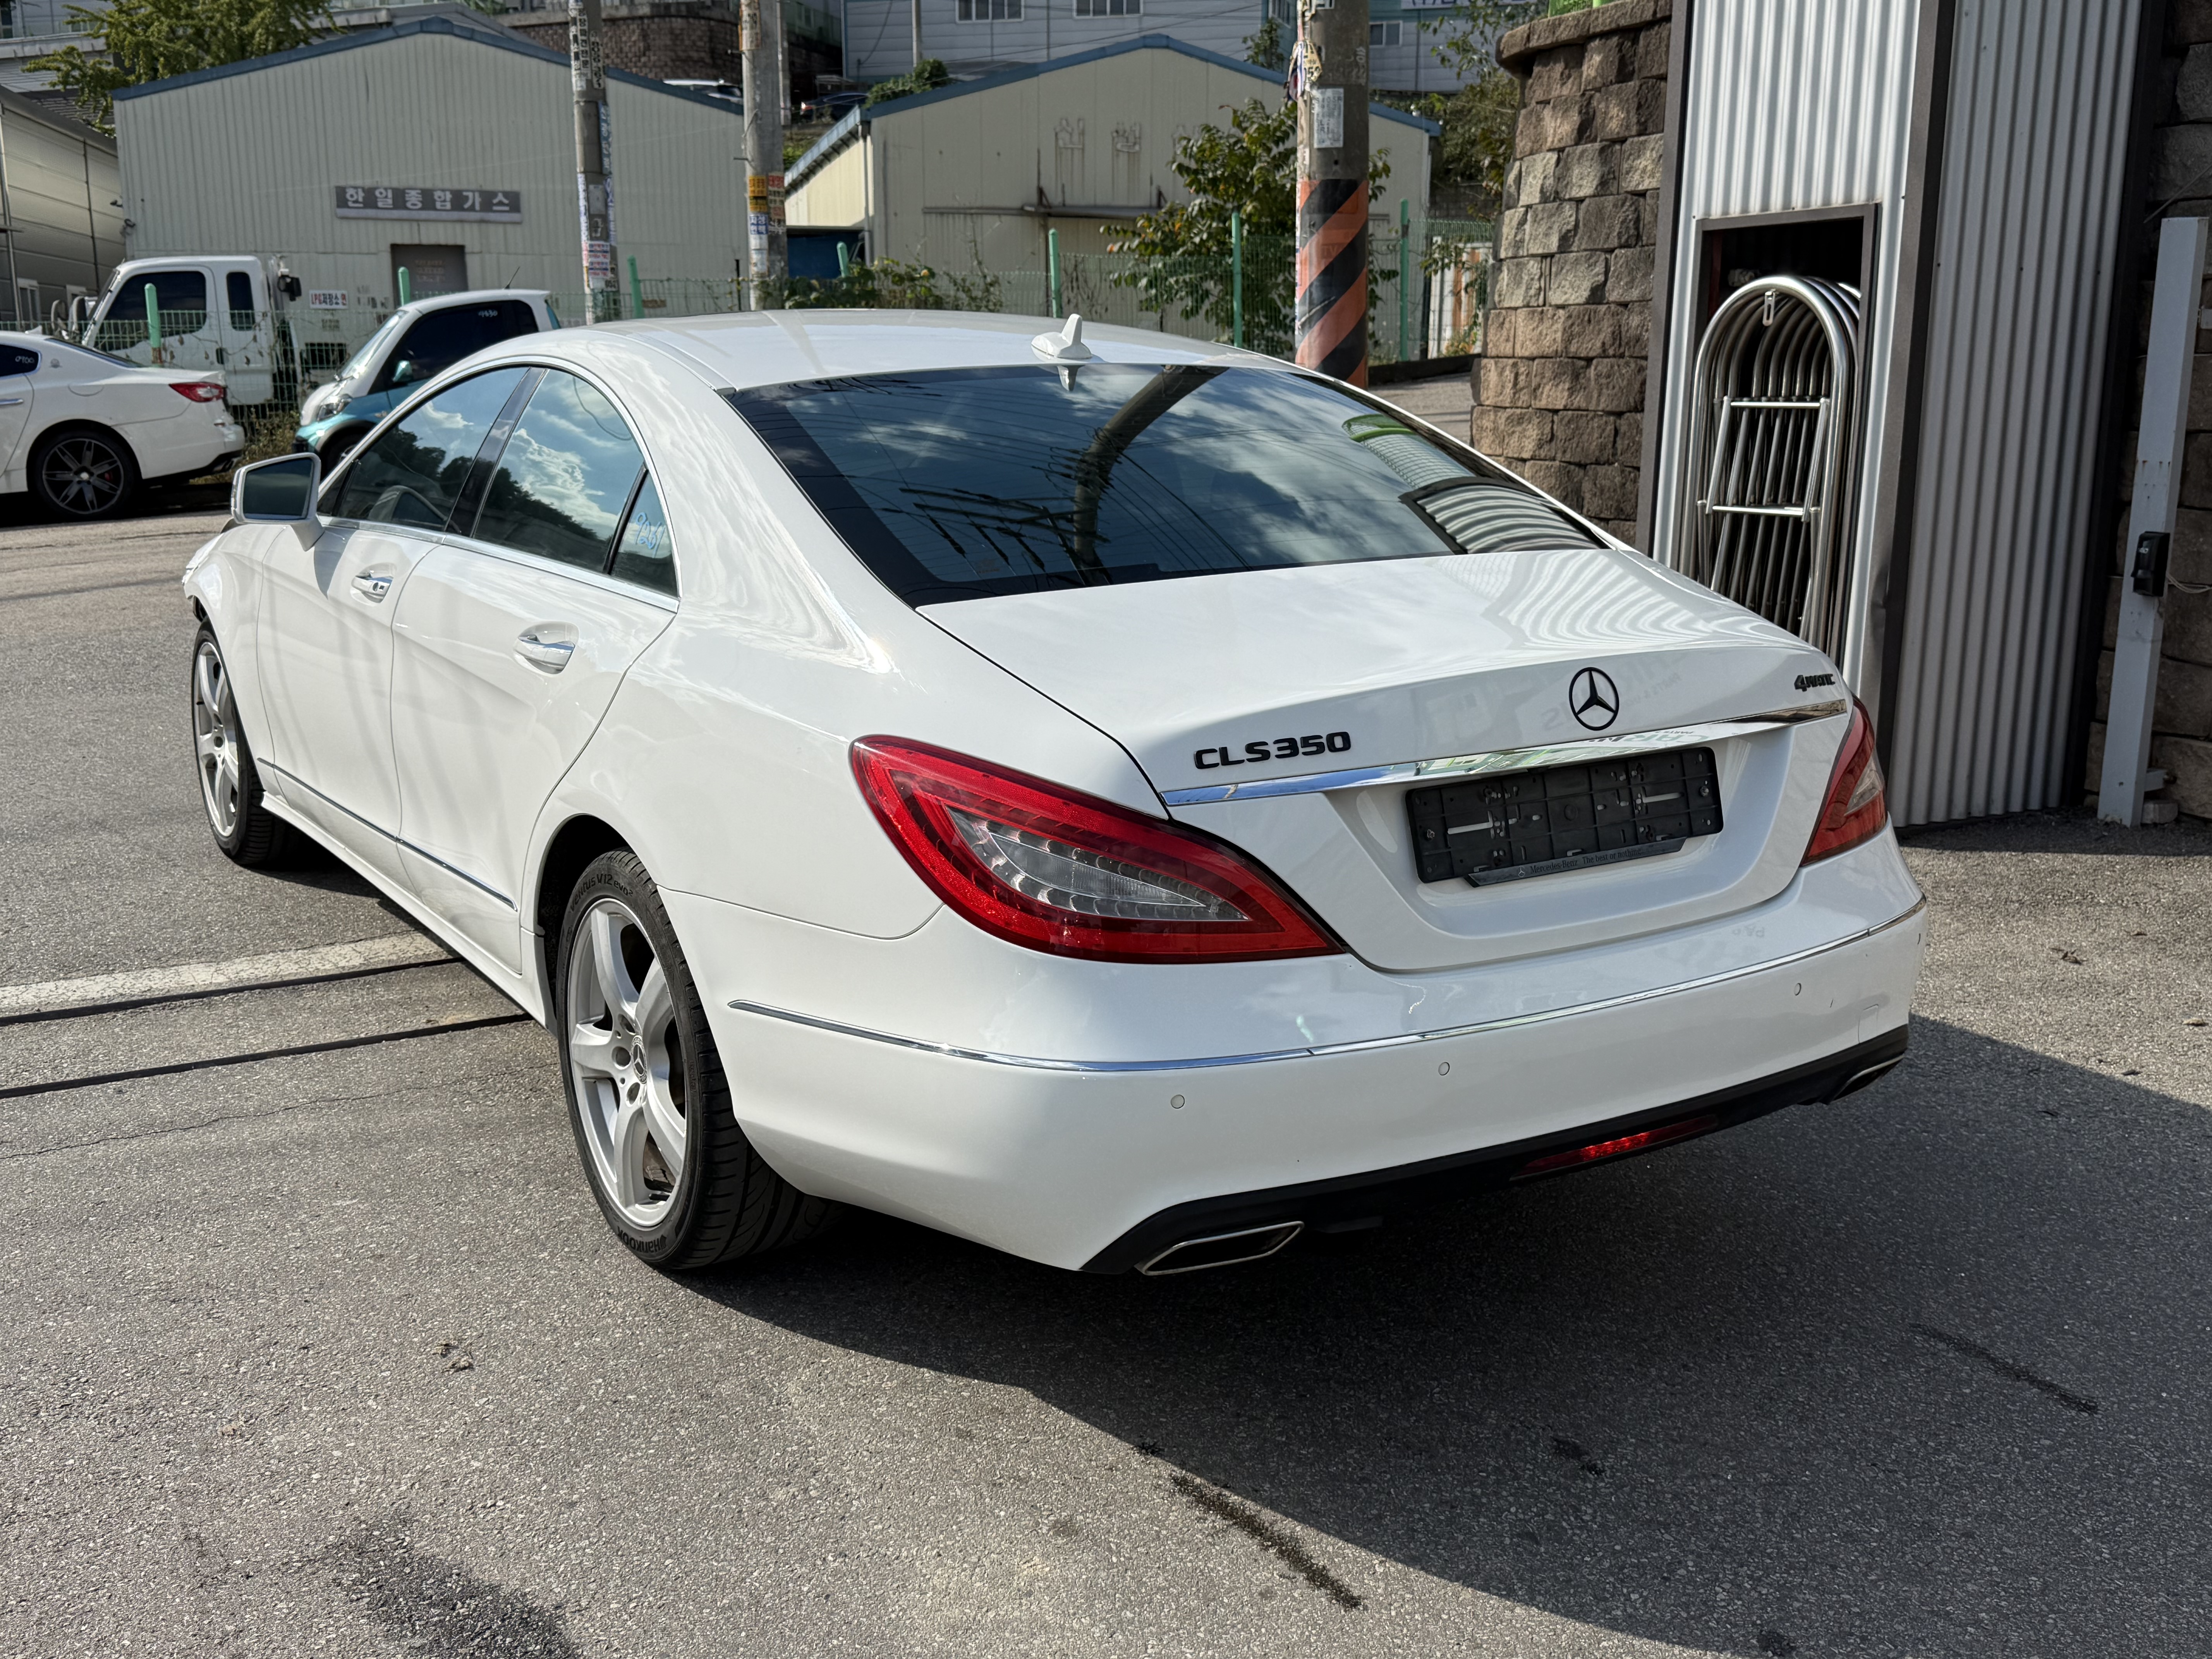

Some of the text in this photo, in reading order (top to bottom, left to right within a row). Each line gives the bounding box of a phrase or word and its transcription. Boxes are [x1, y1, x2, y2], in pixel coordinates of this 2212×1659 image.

[345, 187, 510, 211] 한일종합가스
[311, 293, 340, 306] LPG저장소
[1794, 673, 1836, 692] 4MATIC
[1194, 732, 1351, 769] CLS350
[1530, 859, 1578, 874] Mercedes-Benz
[1582, 856, 1594, 864] The
[1595, 854, 1608, 862] best
[597, 873, 613, 886] V12
